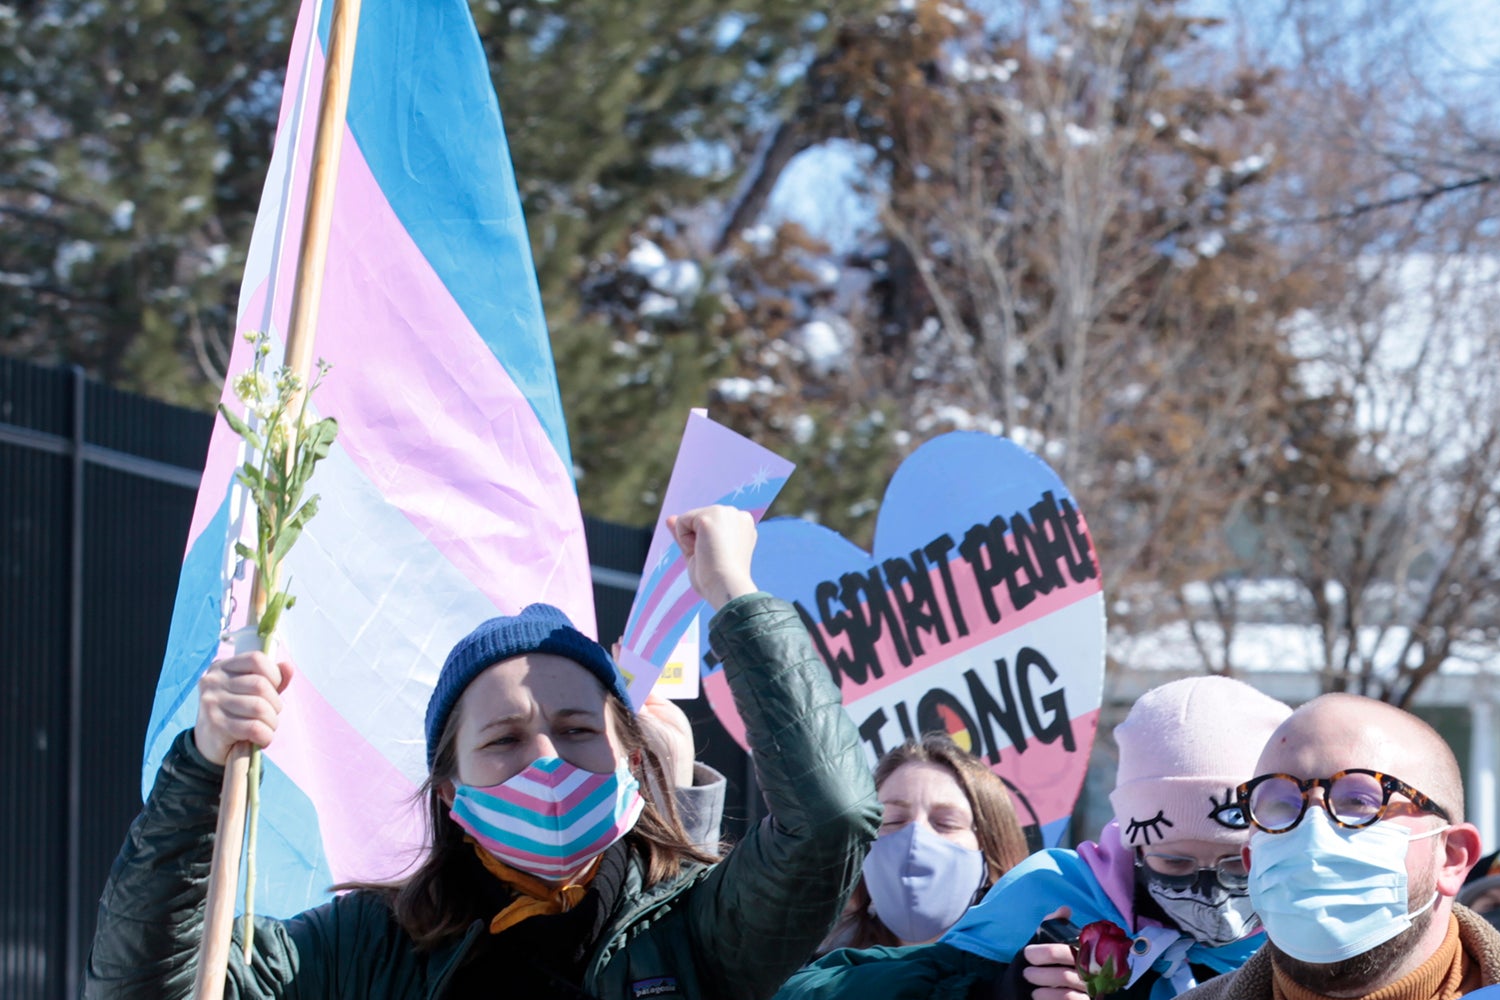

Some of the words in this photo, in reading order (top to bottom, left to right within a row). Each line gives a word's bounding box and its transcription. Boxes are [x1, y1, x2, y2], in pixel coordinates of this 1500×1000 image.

[815, 533, 969, 684] SPIRIT
[958, 490, 1098, 625] PEOPLE
[636, 985, 676, 998] patagonia
